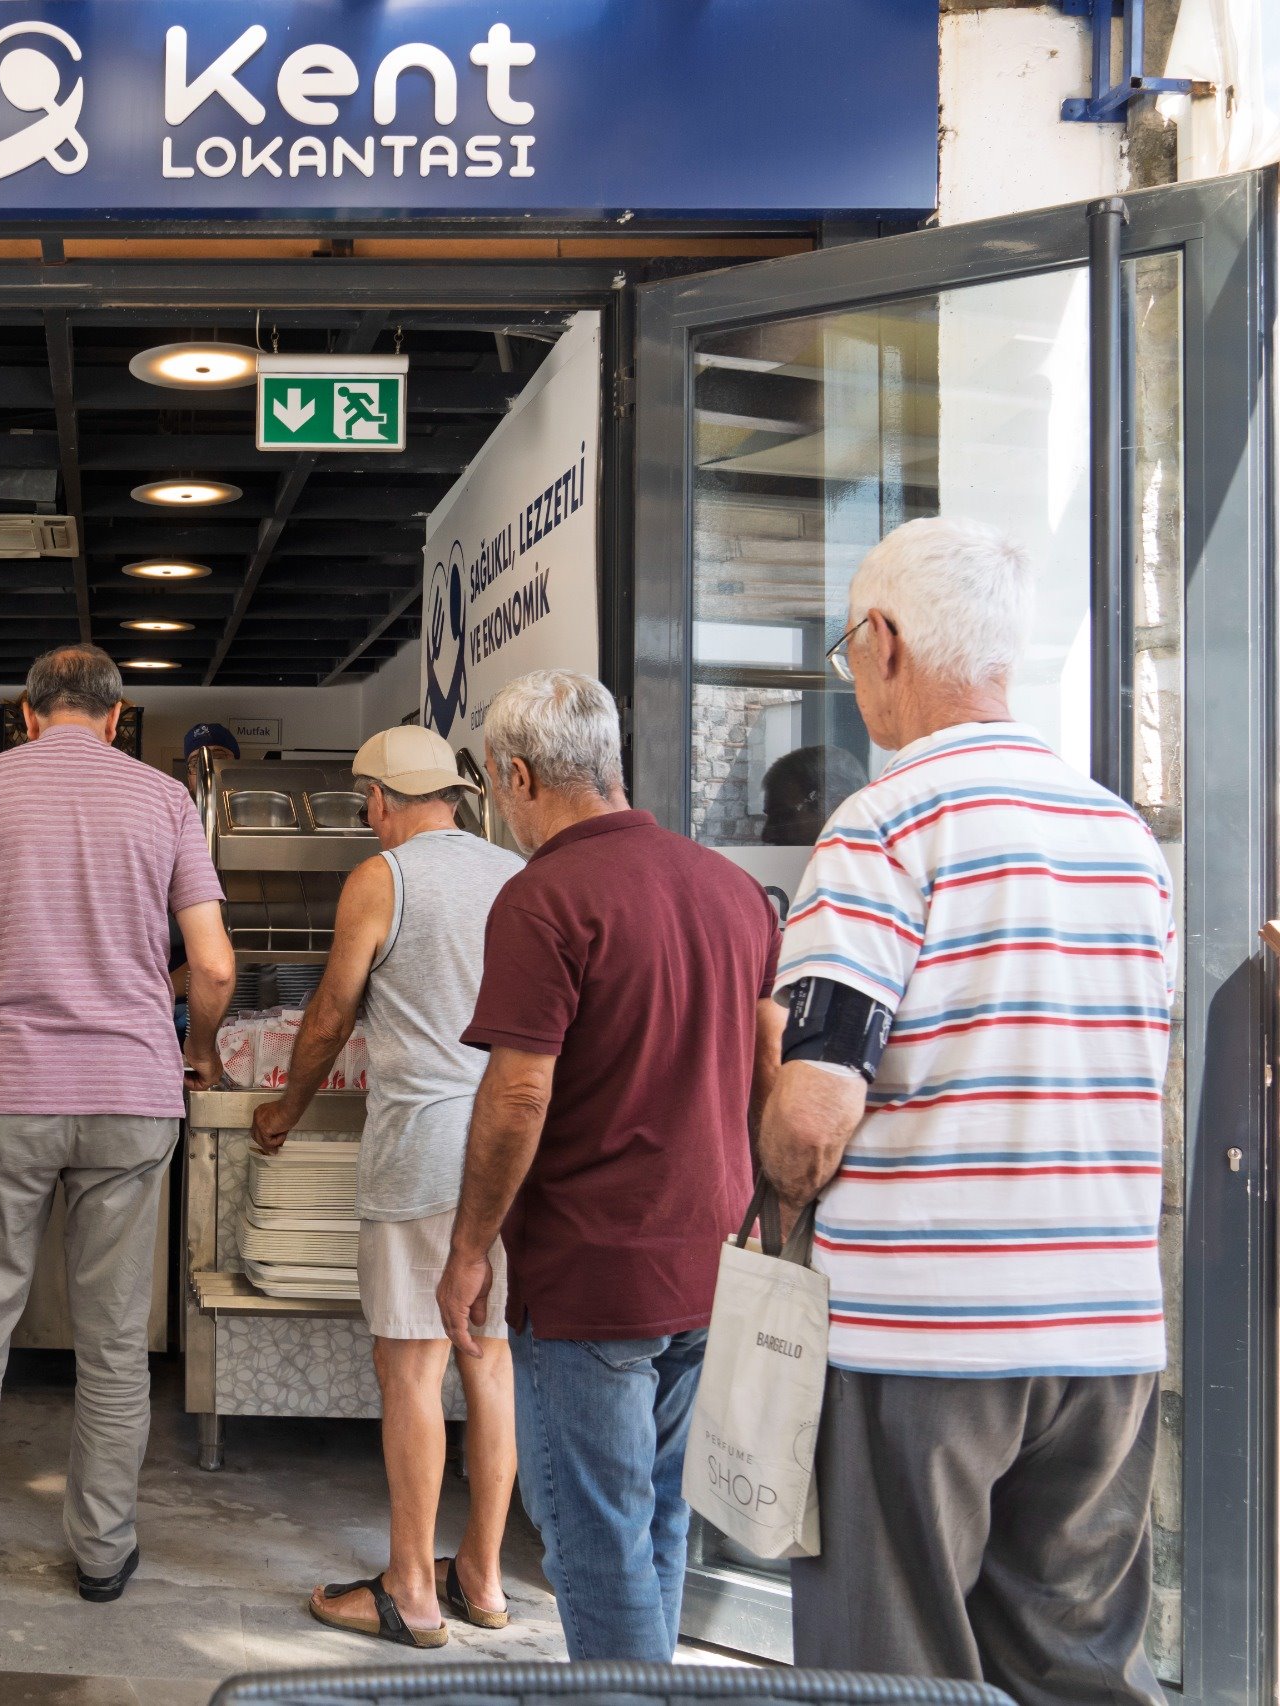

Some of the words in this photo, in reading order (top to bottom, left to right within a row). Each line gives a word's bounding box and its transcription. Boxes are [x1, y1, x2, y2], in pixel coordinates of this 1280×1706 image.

[164, 22, 536, 126] Kent
[162, 135, 536, 178] LOKANTASI
[469, 523, 516, 604] SAĞLIKLI,
[519, 440, 586, 556] LEZZETLİ
[470, 624, 481, 666] VE
[482, 561, 551, 659] EKONOMİK
[236, 726, 270, 736] Mutfak
[756, 1331, 803, 1359] BARGELLO
[705, 1430, 753, 1465] PERFUME
[707, 1454, 778, 1511] SHOP
